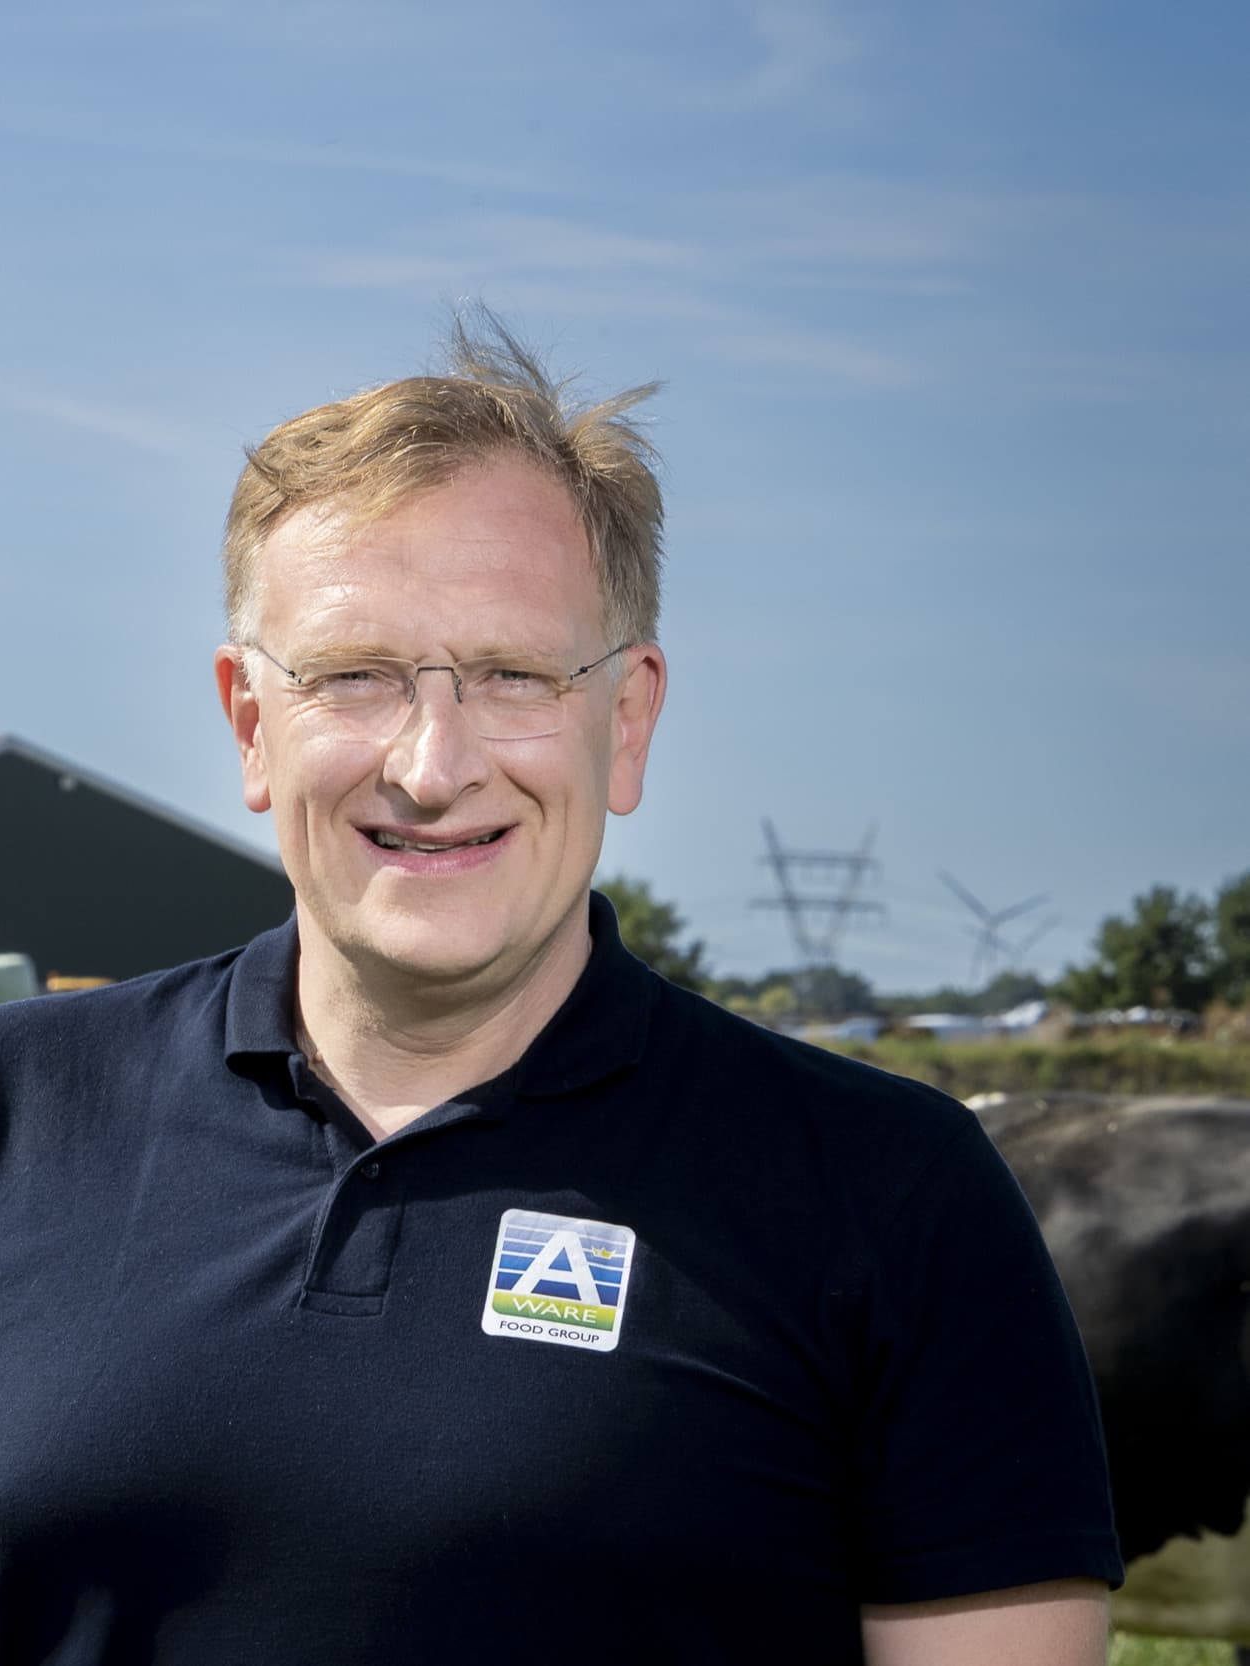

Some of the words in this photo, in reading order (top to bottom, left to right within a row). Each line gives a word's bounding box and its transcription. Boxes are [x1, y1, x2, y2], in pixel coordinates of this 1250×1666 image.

[511, 1230, 602, 1305] A
[512, 1297, 598, 1323] WARE
[499, 1320, 543, 1334] FOOD
[548, 1328, 600, 1343] GROUP
